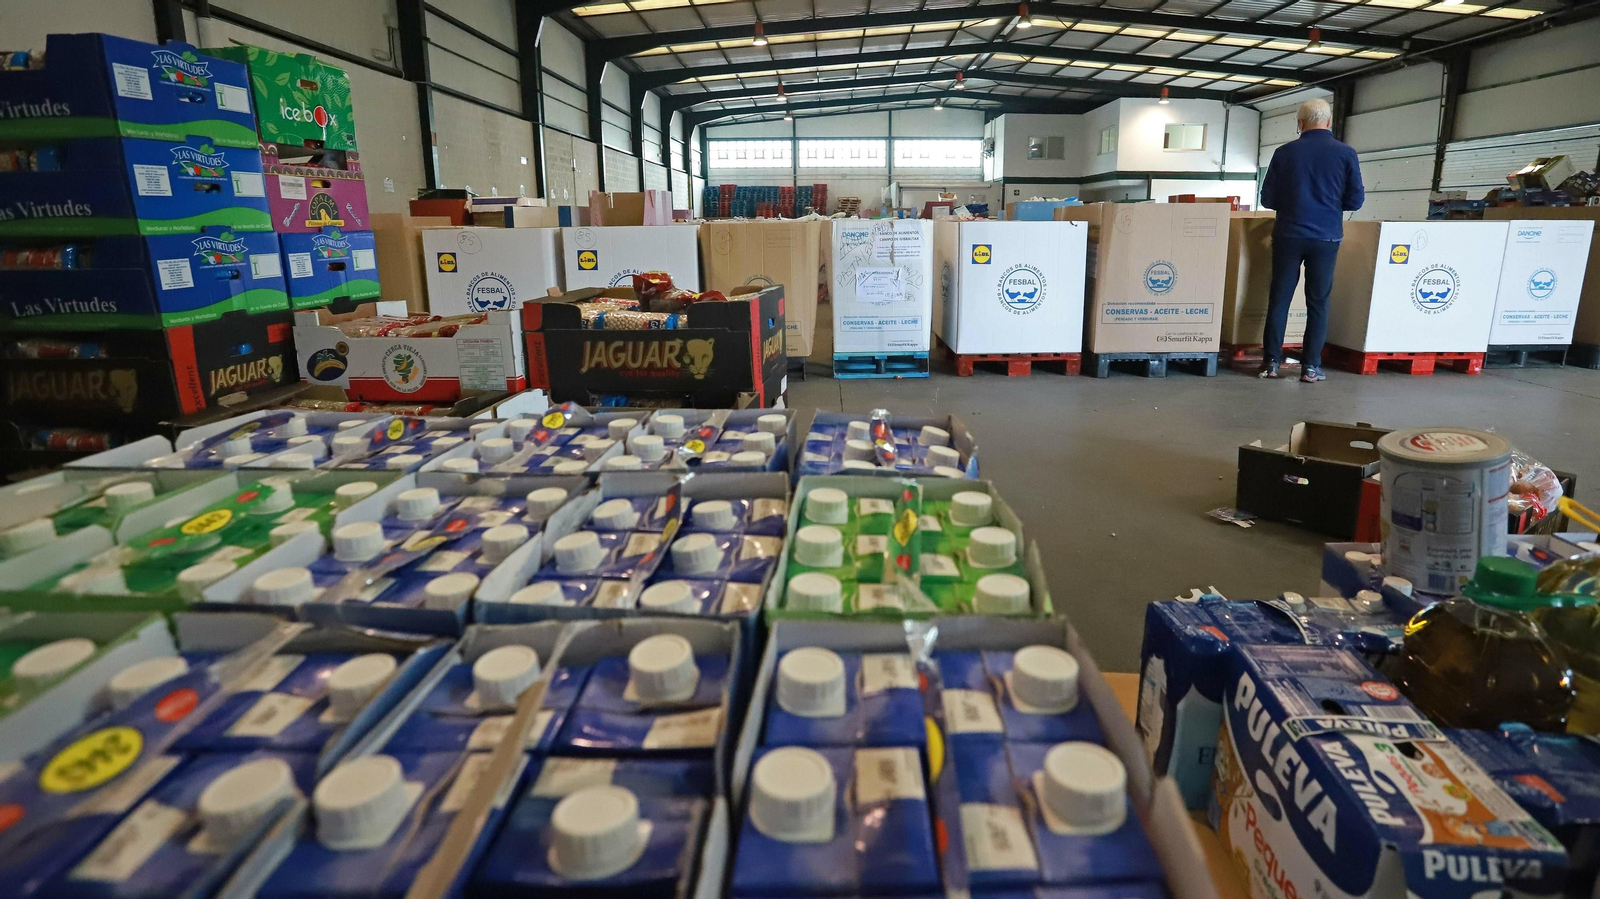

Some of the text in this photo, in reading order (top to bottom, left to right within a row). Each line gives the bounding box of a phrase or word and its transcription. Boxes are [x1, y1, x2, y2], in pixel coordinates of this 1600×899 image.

[159, 54, 205, 75] LAS VIRTUDES
[178, 150, 222, 167] LAS VIRTUDES
[0, 200, 92, 221] as Virtudes
[199, 240, 241, 252] LAS VIRTUDES
[317, 238, 346, 248] LAS VIRTUDES
[466, 274, 481, 296] BANCOS
[490, 271, 516, 296] ALIMENTOS
[608, 272, 622, 288] ANCOS
[998, 266, 1014, 287] BANCOS
[1024, 264, 1047, 287] ALIMENTOS
[1412, 267, 1430, 287] BANCOS
[1440, 264, 1461, 287] ALIMENTOS
[11, 296, 118, 318] Las Virtudes
[997, 292, 1012, 313] BANCOS
[1022, 292, 1047, 315] ALIMENTOS
[1410, 292, 1423, 312] BANCOS
[1433, 292, 1460, 315] ALIMENTOS
[385, 344, 419, 357] CERCA VIEJA
[579, 338, 684, 374] JAGUAR
[8, 369, 106, 405] JAGUAR
[210, 358, 268, 395] JAGUAR
[1315, 718, 1410, 738] PULEVA
[1234, 670, 1338, 855] PULEVA
[1319, 740, 1406, 827] PULEVA
[1246, 801, 1301, 899] Peque
[1422, 850, 1543, 882] PULEVA
